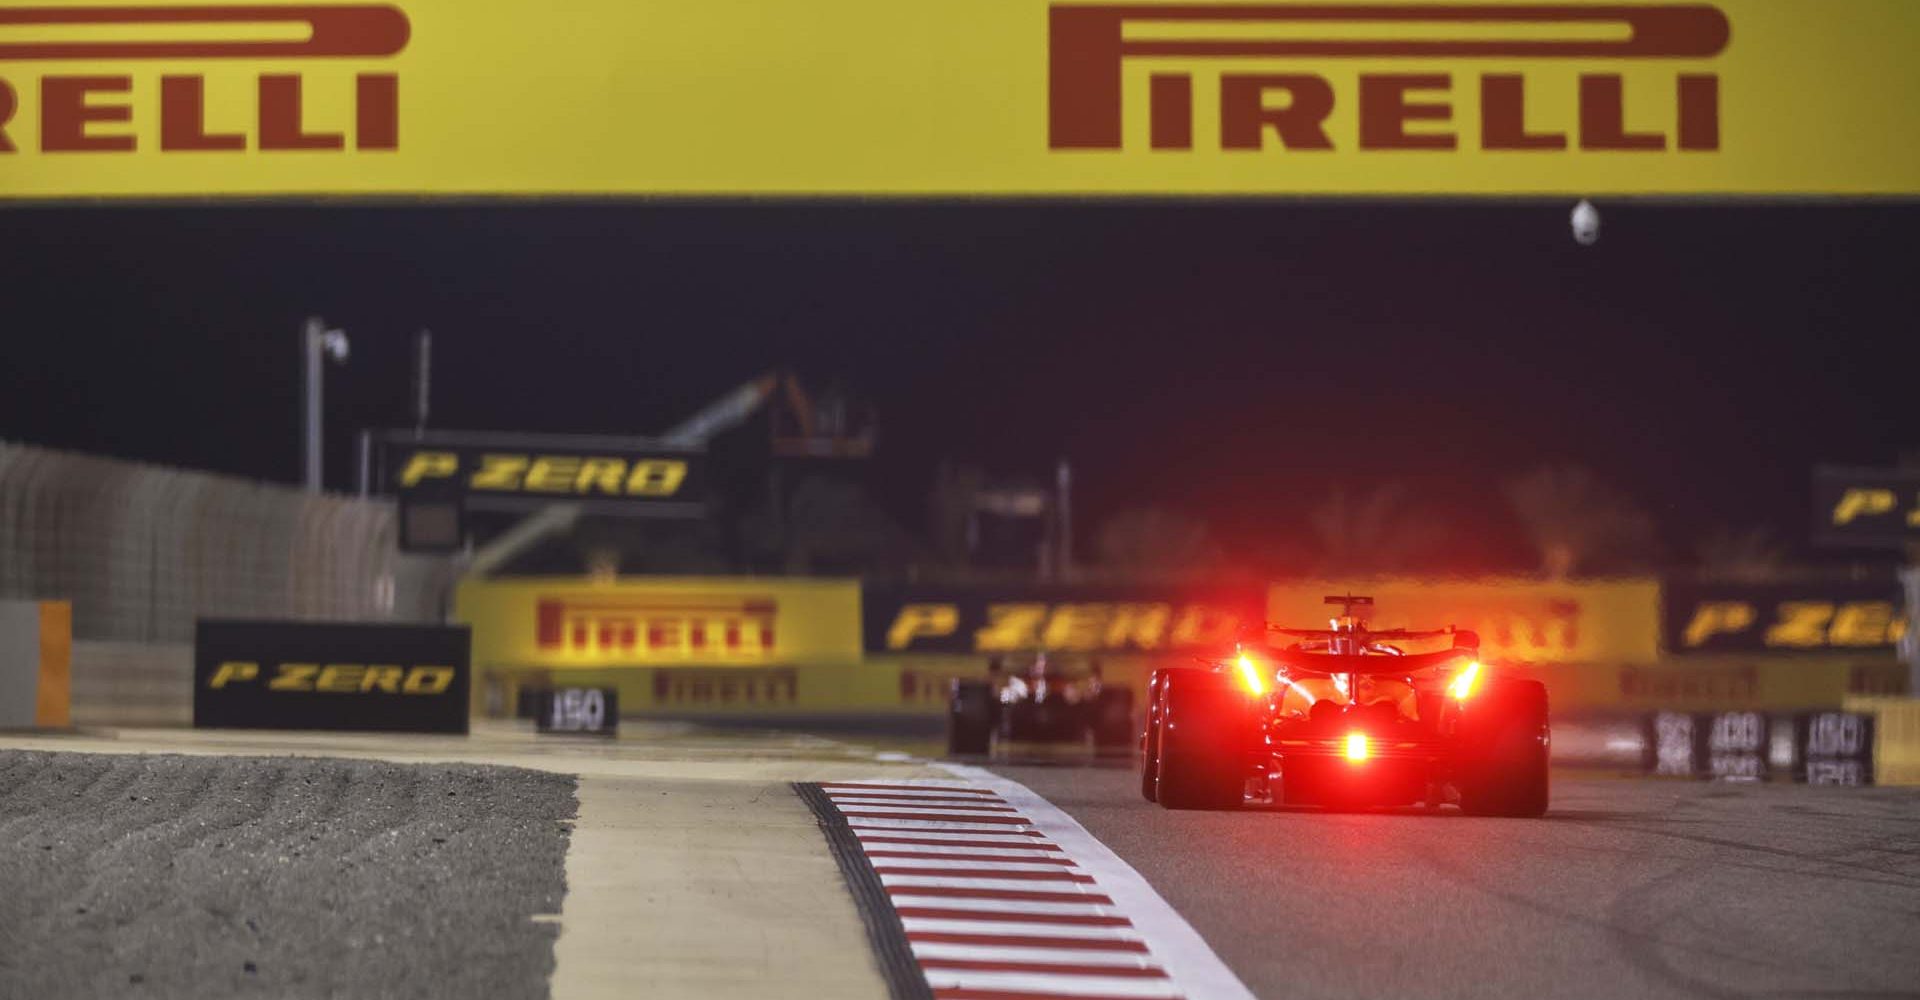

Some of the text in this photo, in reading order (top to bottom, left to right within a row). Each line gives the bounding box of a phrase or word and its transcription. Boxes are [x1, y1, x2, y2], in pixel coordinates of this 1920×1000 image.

[0, 5, 411, 153] ELLI
[1048, 3, 1731, 152] PIRELLI
[401, 453, 688, 497] P ZERO
[537, 598, 777, 649] PIRELLI
[886, 603, 960, 650] P
[1682, 602, 1757, 648] P
[209, 661, 456, 694] P ZERO
[552, 687, 605, 731] 150
